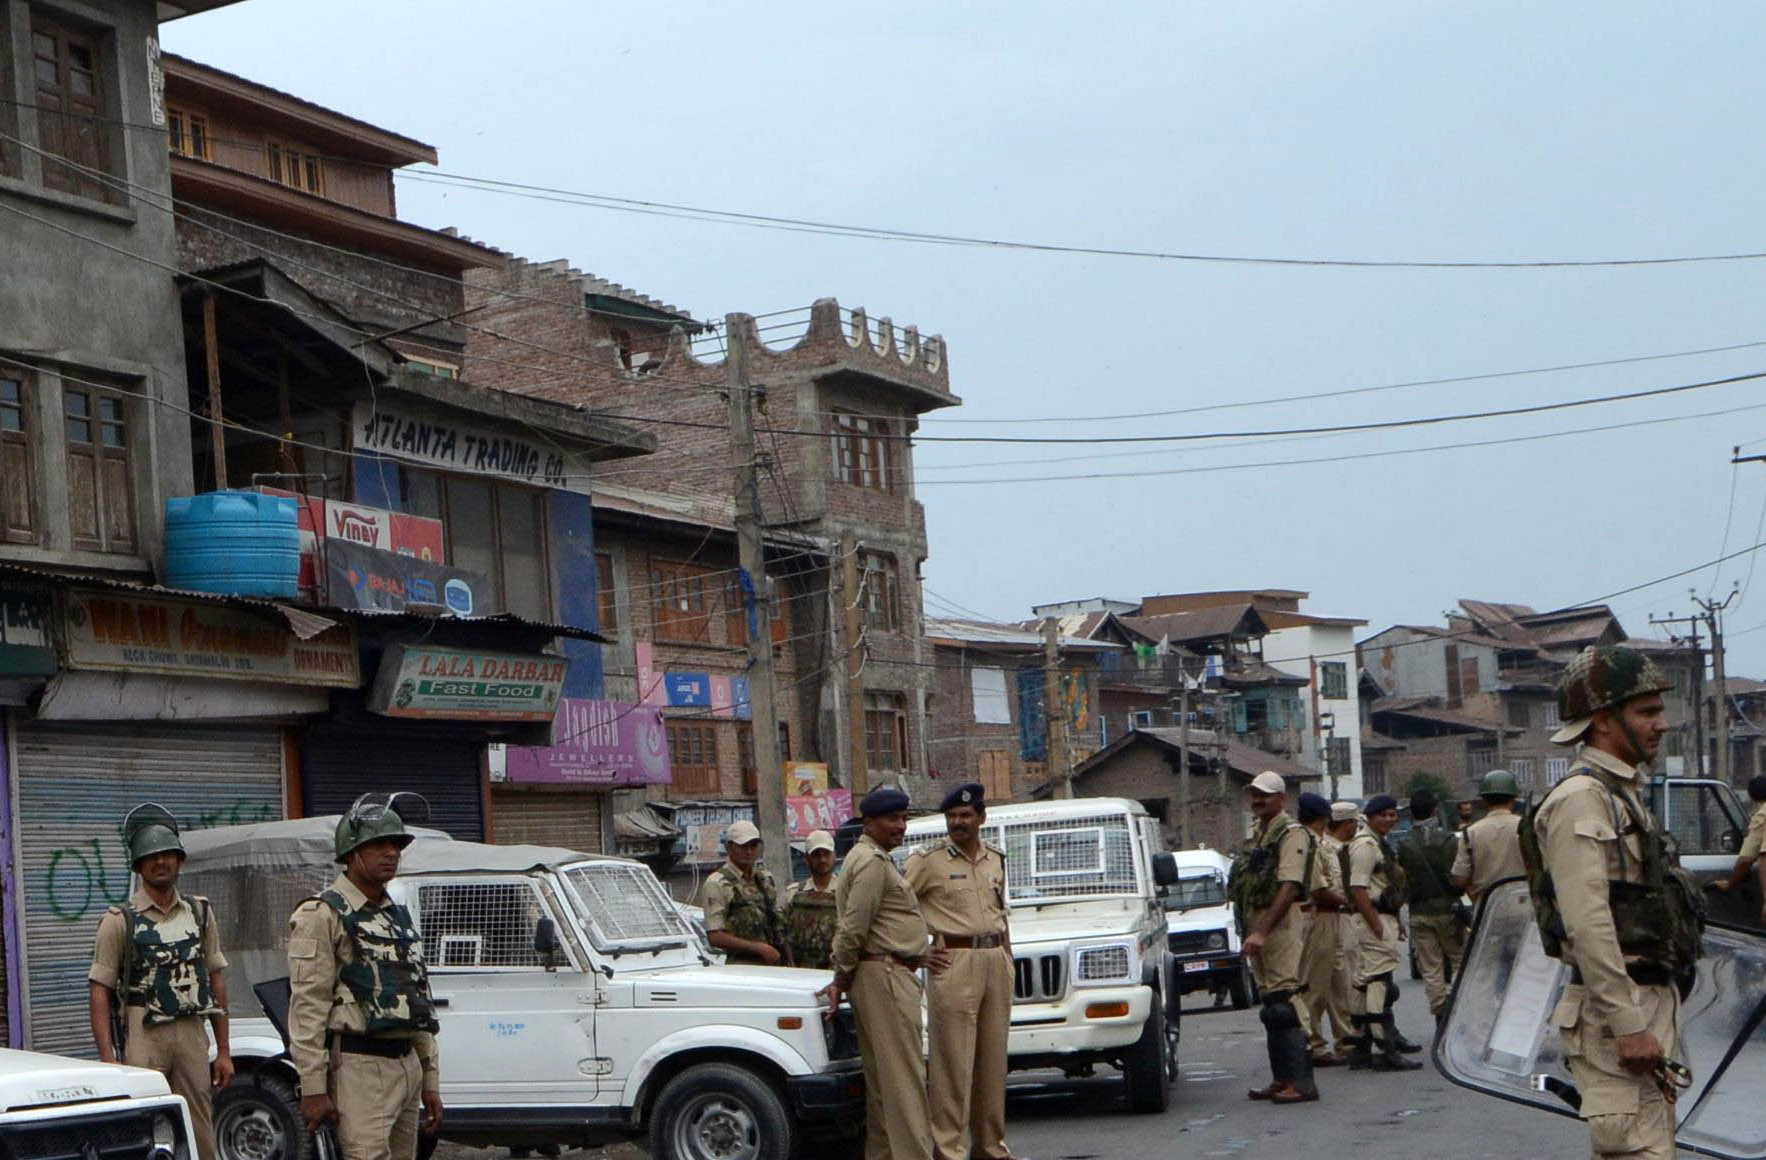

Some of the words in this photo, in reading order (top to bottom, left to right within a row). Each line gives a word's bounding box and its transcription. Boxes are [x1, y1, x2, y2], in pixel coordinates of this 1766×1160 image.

[364, 413, 456, 462] ATLANTA
[464, 435, 539, 481] TRADING
[418, 654, 475, 678] LALA
[480, 655, 564, 682] DARBAR
[429, 680, 477, 696] Fast
[484, 683, 536, 698] Food
